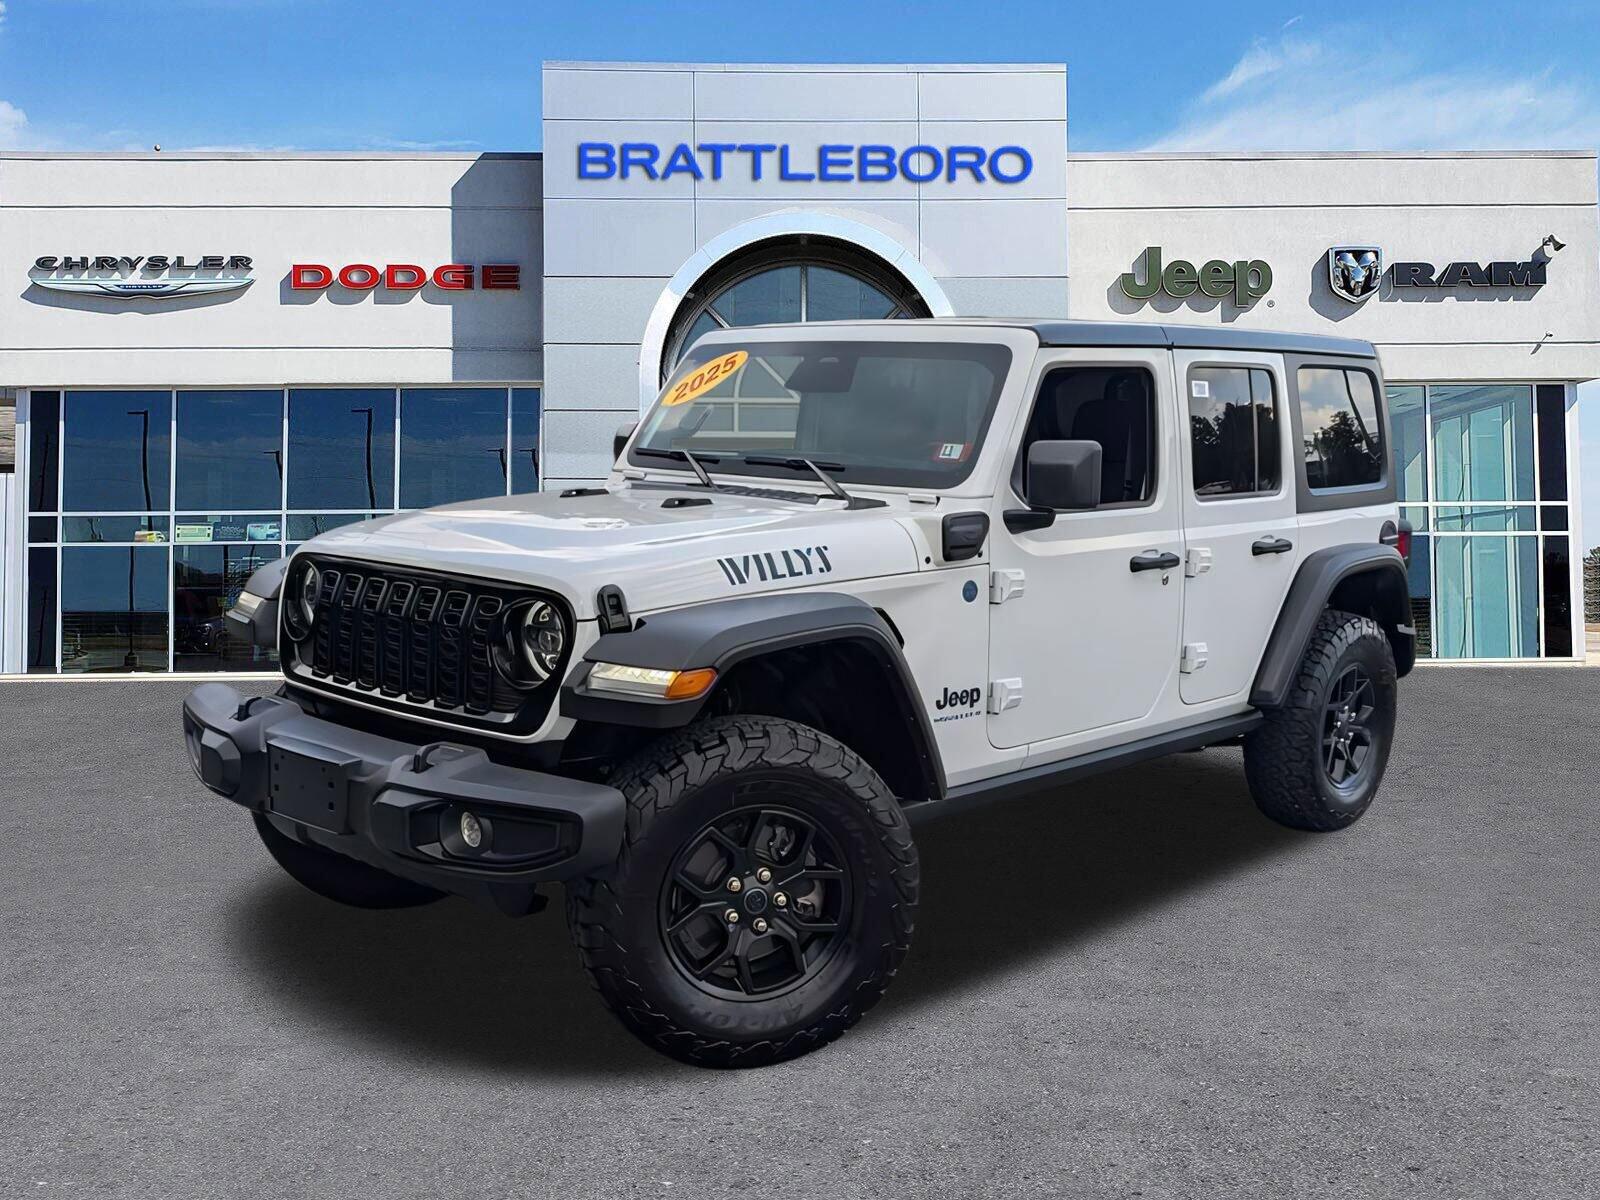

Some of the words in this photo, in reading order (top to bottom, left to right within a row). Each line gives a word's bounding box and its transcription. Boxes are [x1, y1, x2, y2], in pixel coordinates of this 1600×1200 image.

[577, 142, 1034, 184] BRATTLEBORO
[34, 255, 253, 271] CHRYSLER
[291, 263, 521, 290] DODGE
[1120, 246, 1273, 308] Jeep
[1394, 262, 1547, 287] RAM
[671, 353, 739, 404] 2025
[716, 545, 833, 585] WILLYS
[935, 687, 981, 710] Jeep
